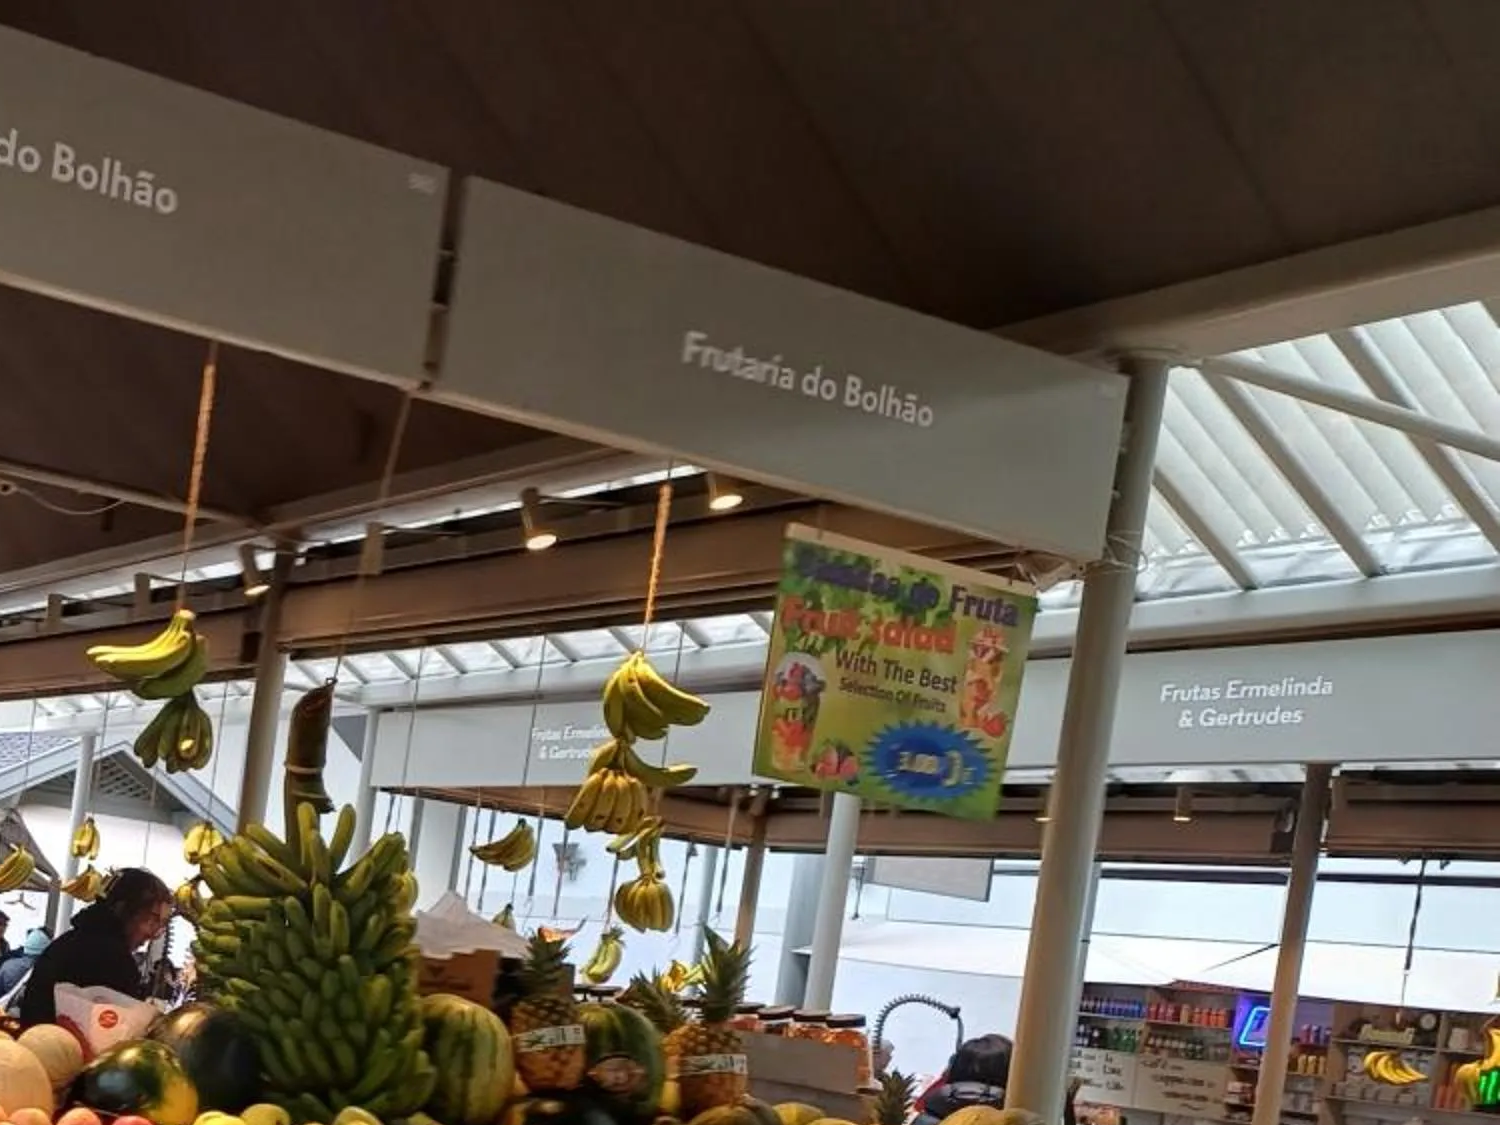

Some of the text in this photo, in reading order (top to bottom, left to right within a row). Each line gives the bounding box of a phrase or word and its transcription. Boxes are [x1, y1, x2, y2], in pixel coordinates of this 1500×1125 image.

[51, 141, 178, 214] Bolhão
[681, 330, 933, 427] Frutaria do Bolhão
[950, 584, 1020, 627] Fruta
[835, 650, 960, 695] With The Best
[839, 676, 894, 702] Selection
[1160, 675, 1333, 702] Frutas Ermelinda
[1177, 705, 1304, 728] & Gertrudes
